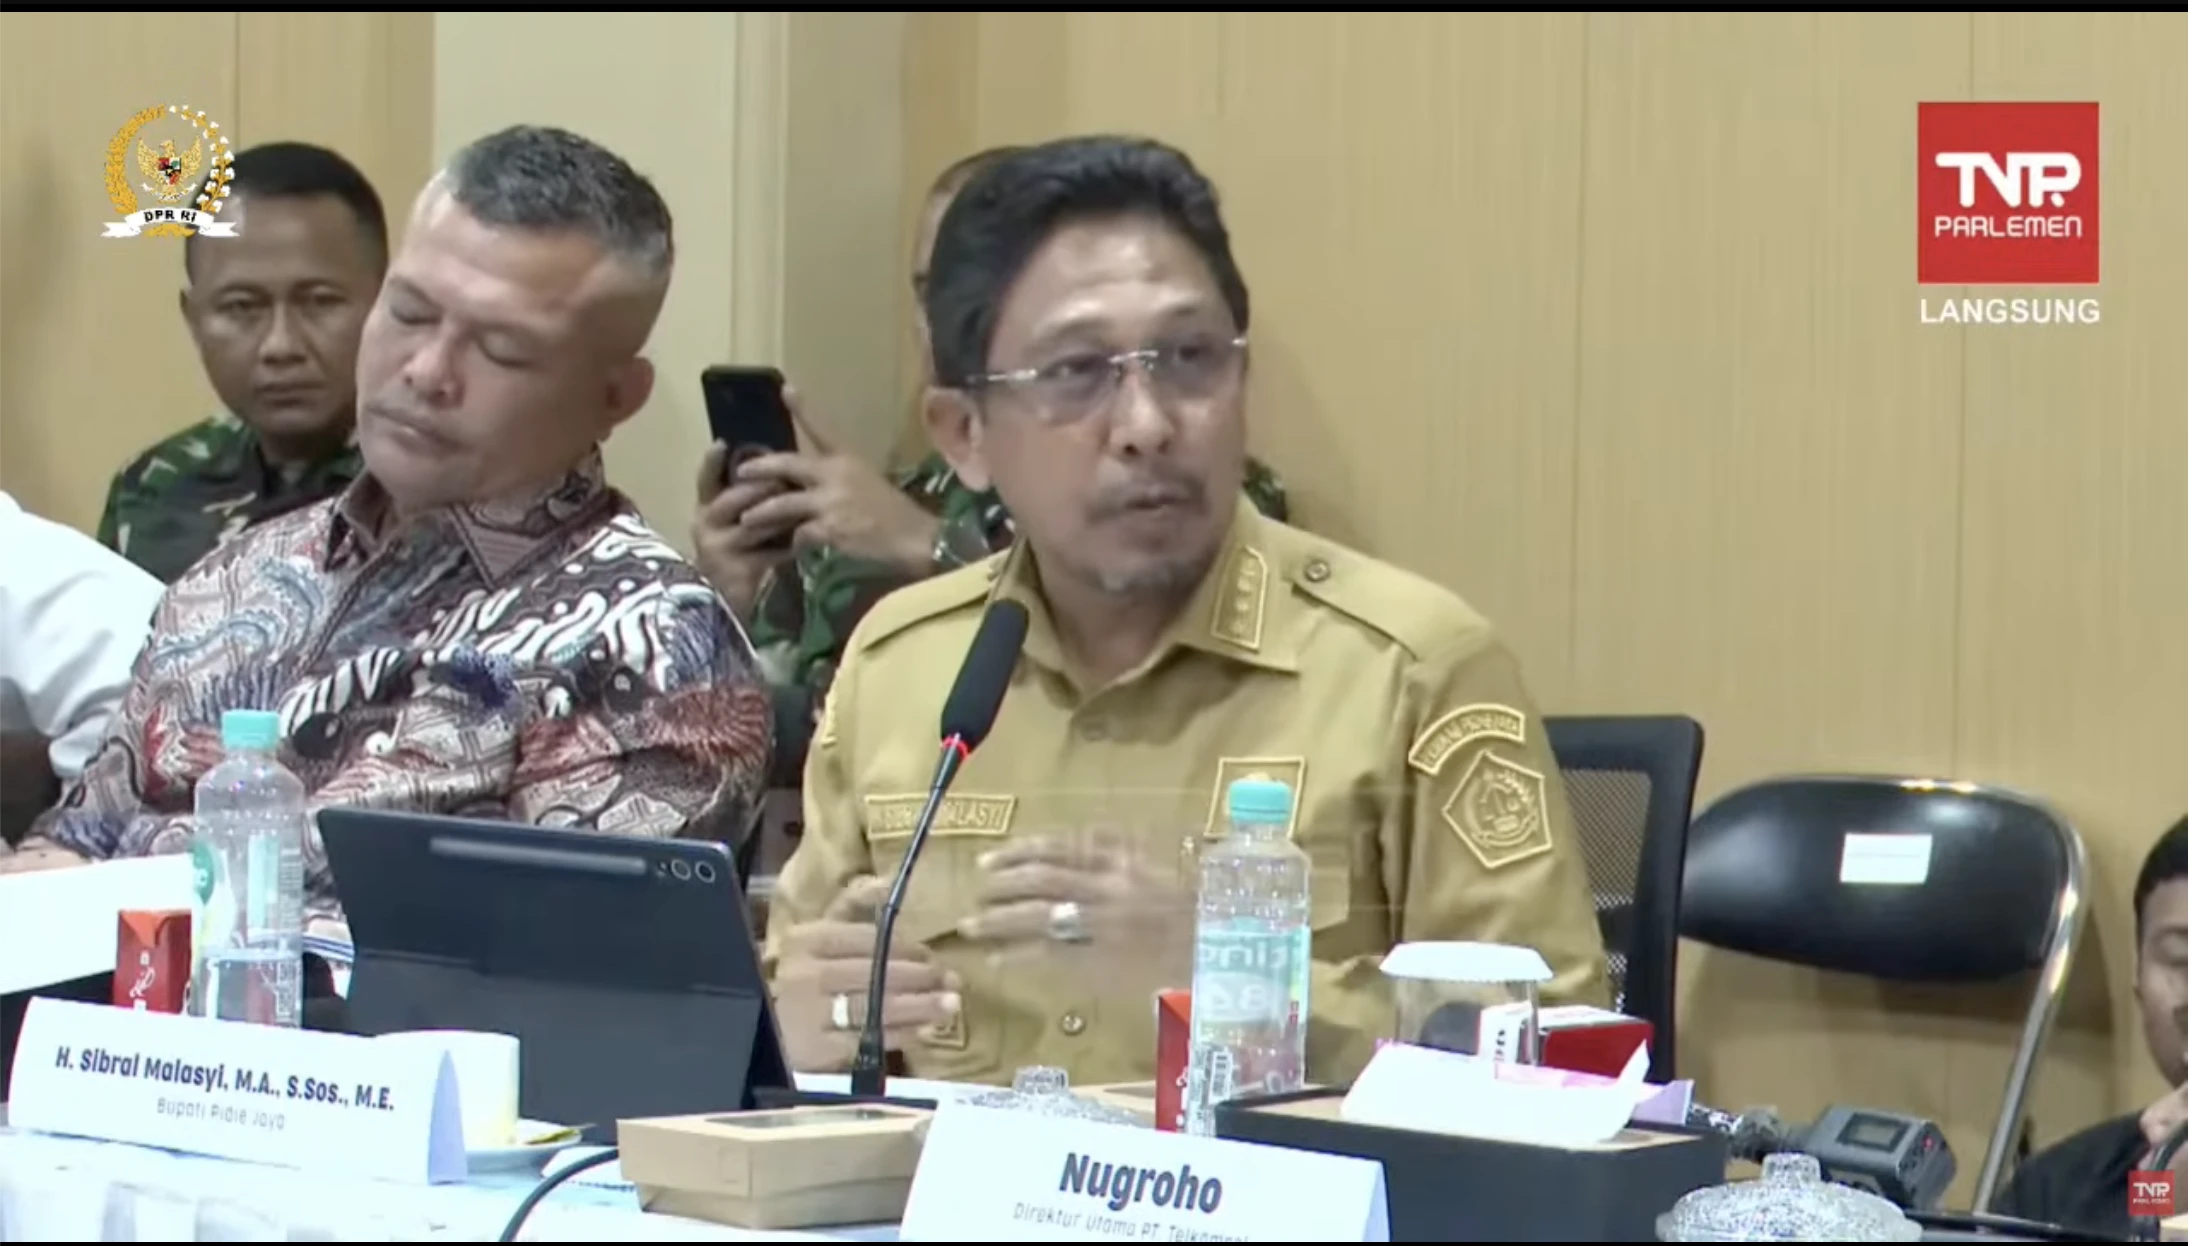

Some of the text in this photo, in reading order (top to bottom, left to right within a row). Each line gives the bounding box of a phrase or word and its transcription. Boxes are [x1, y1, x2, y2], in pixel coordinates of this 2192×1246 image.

[55, 1045, 395, 1111] H. Sibral Malasyi, M.A., S.Sos., M.E.
[157, 1097, 206, 1119] Bupati
[210, 1103, 248, 1126] Pidie
[1059, 1152, 1223, 1214] Nugroho
[1013, 1202, 1082, 1229] Direktur
[1086, 1214, 1136, 1237] Utama
